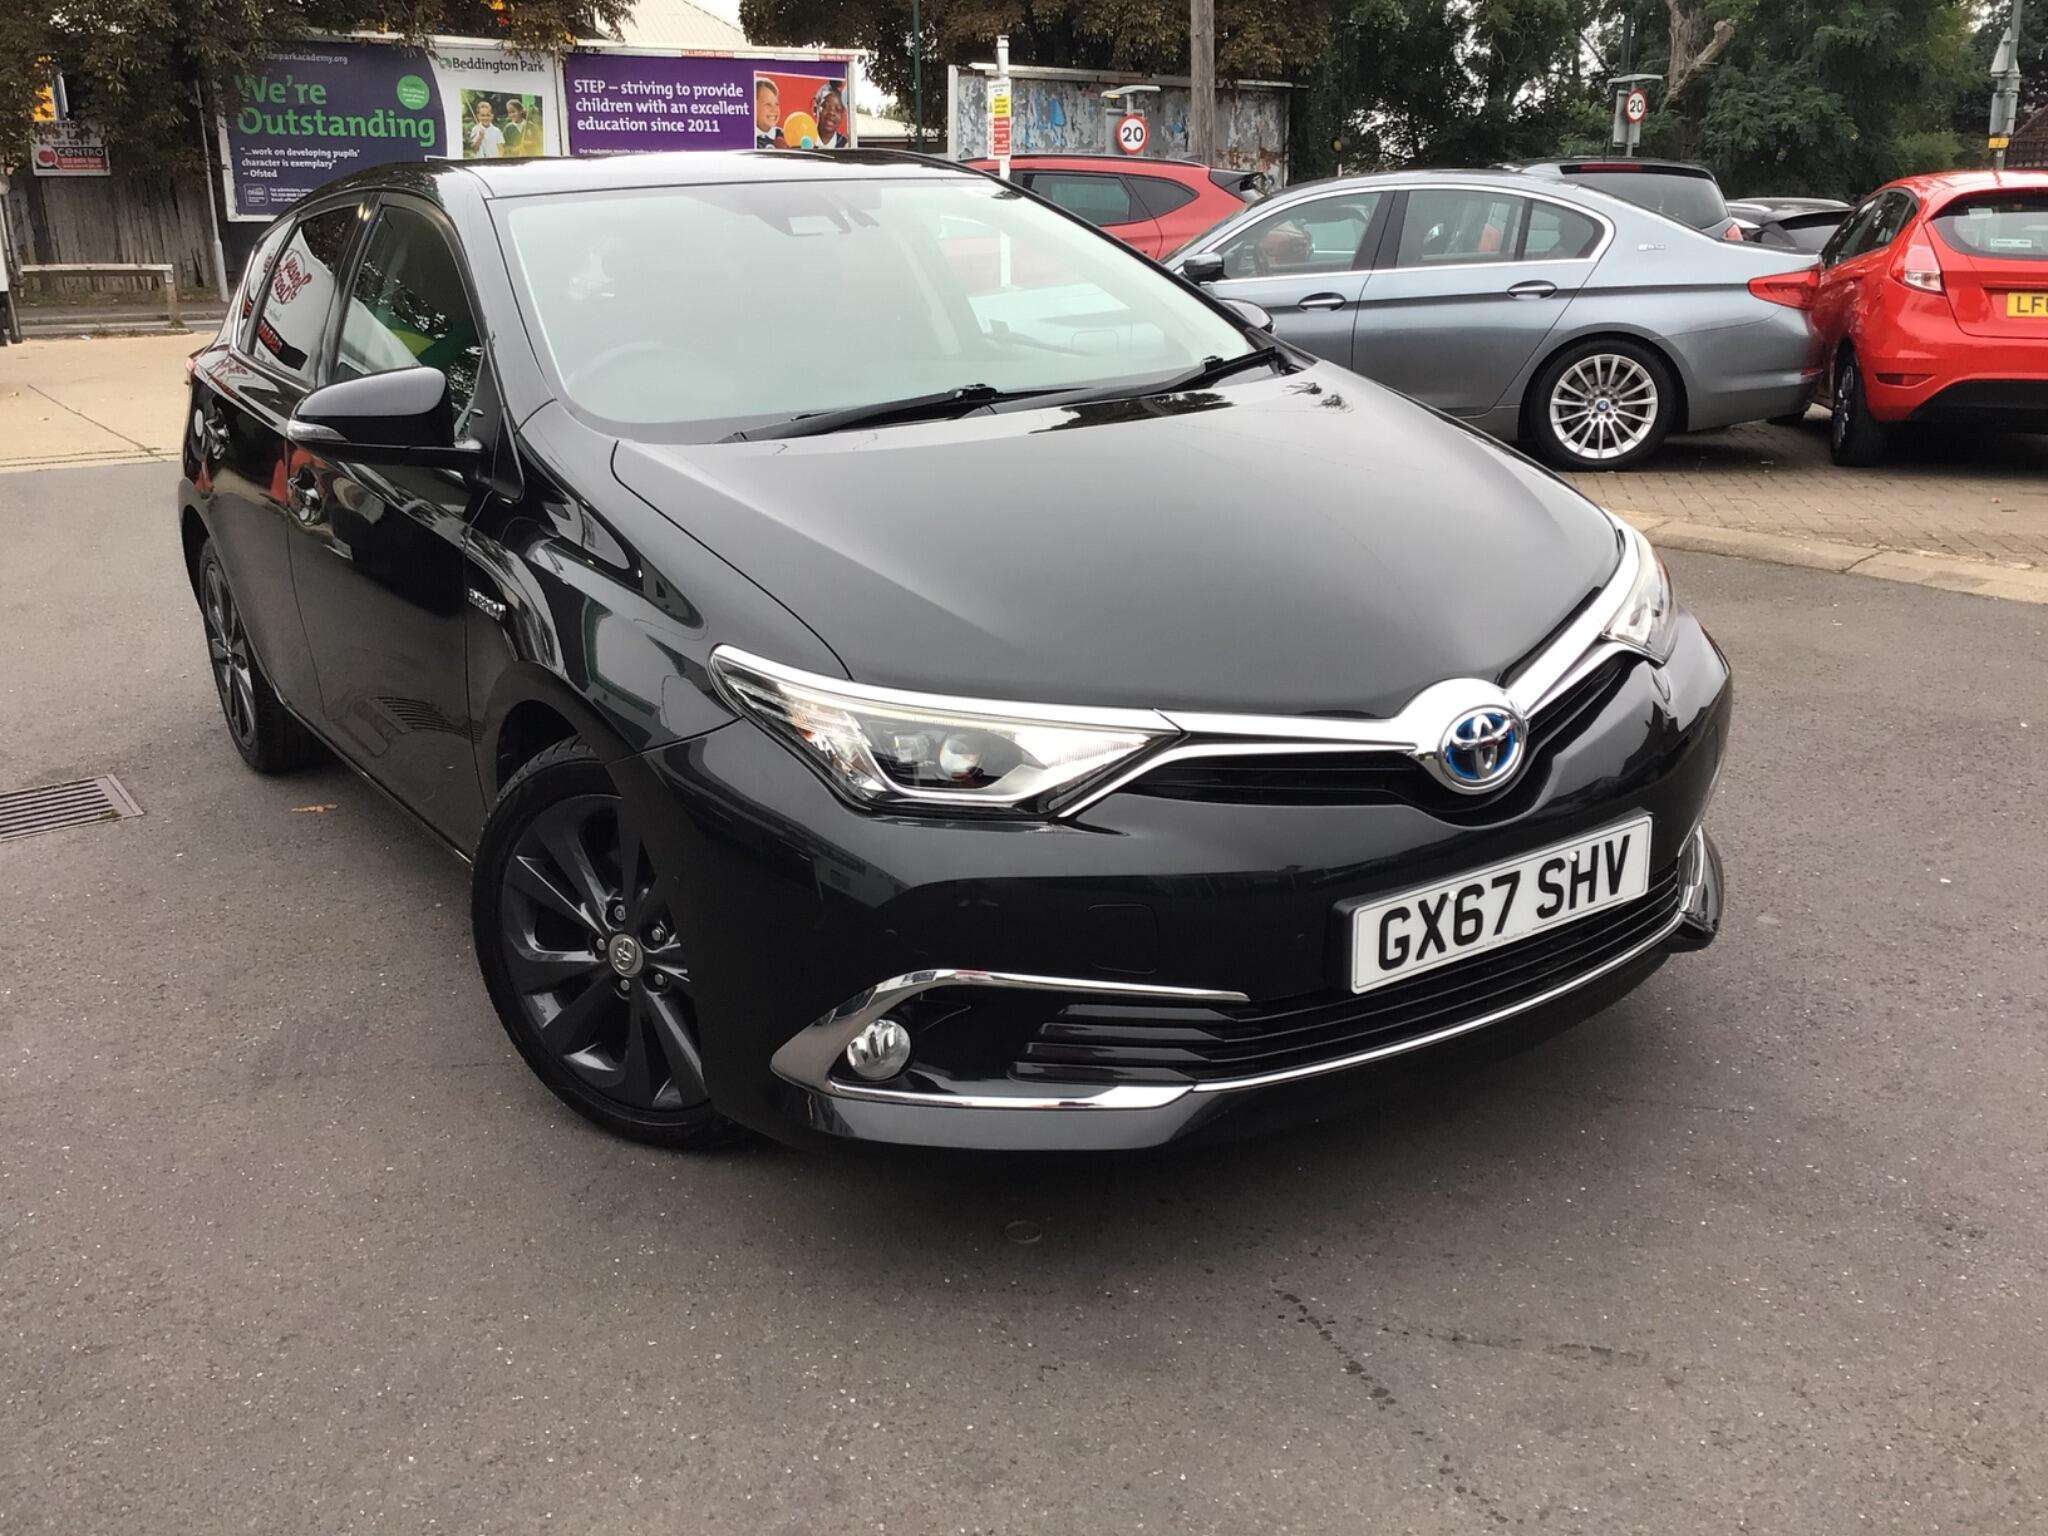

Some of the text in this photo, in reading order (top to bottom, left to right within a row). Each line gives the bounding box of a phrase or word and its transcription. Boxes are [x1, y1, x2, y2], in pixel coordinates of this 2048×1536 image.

[453, 57, 545, 73] Beddington Park
[236, 75, 327, 104] We're
[574, 79, 605, 93] STEP
[620, 81, 673, 99] striving
[676, 83, 690, 95] to
[693, 83, 743, 100] provide
[576, 98, 750, 115] children with an excellent
[1630, 100, 1643, 112] 20
[238, 107, 435, 147] Outstanding
[577, 117, 720, 132] education since 2011
[1122, 127, 1144, 142] 20
[286, 148, 331, 159] developing
[241, 158, 281, 167] character
[281, 159, 289, 167] is
[250, 169, 278, 178] Ofsted
[2017, 296, 2048, 313] LF
[1379, 834, 1631, 970] GX67 SHV
